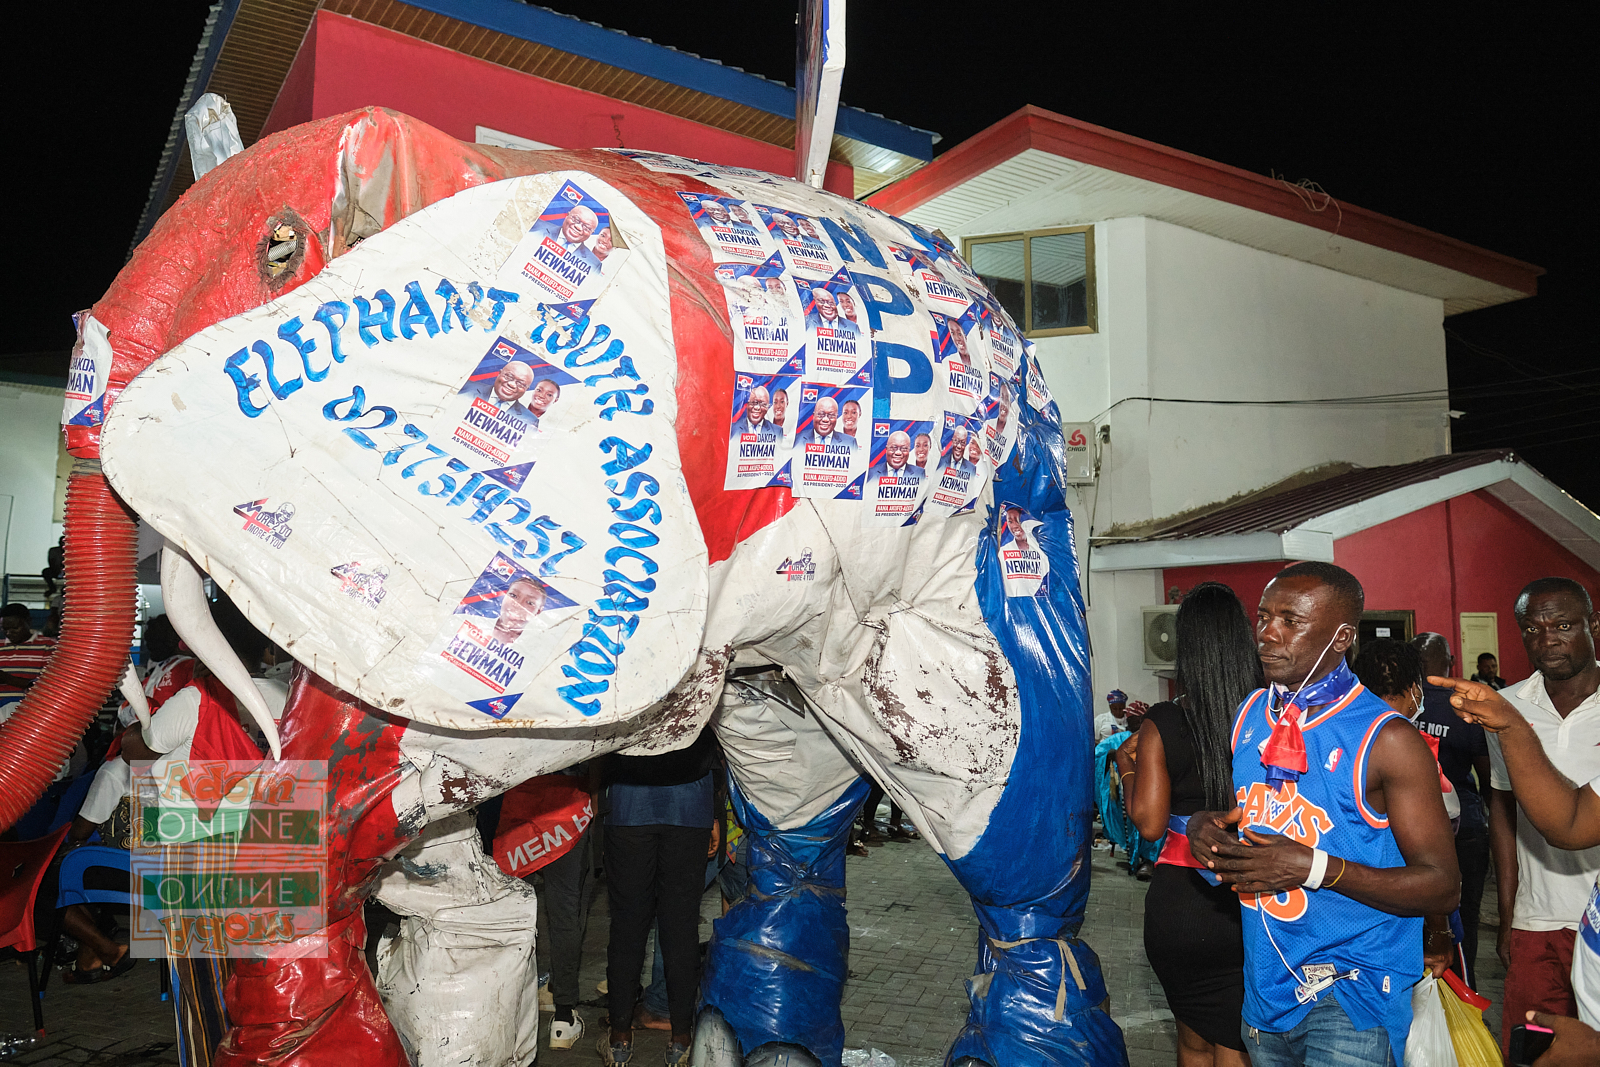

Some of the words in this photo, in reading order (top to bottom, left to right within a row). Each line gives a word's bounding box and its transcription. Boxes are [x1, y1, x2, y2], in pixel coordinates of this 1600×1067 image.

[715, 232, 762, 247] NEWMAN
[545, 239, 565, 256] VOTE
[563, 251, 592, 275] DAKOA
[786, 245, 830, 261] NEWMAN
[534, 246, 587, 287] NEWMAN
[925, 281, 968, 301] NEWMAN
[818, 328, 833, 336] VOTE
[834, 329, 856, 341] DAKOA
[223, 279, 520, 419] ELEPHANT
[817, 337, 857, 355] NEWMAN
[950, 362, 965, 372] VOTE
[949, 371, 984, 396] NEWMAN
[476, 399, 498, 415] VOTE
[496, 409, 528, 435] DAKOA
[456, 427, 473, 443] NANA
[464, 407, 523, 448] NEWMAN
[757, 433, 776, 443] DAKOA
[739, 444, 776, 458] NEWMAN
[807, 444, 824, 452] VOTE
[825, 444, 851, 456] DAKOA
[804, 453, 851, 469] NEWMAN
[897, 476, 920, 486] DAKOA
[939, 475, 969, 494] NEWMAN
[877, 486, 919, 499] NEWMAN
[247, 523, 266, 540] MORE
[264, 532, 271, 543] 4
[270, 536, 285, 550] YOU
[1005, 560, 1042, 575] NEWMAN
[446, 635, 518, 688] NEWMAN
[486, 638, 525, 670] DAKOA
[1427, 722, 1450, 738] NOT
